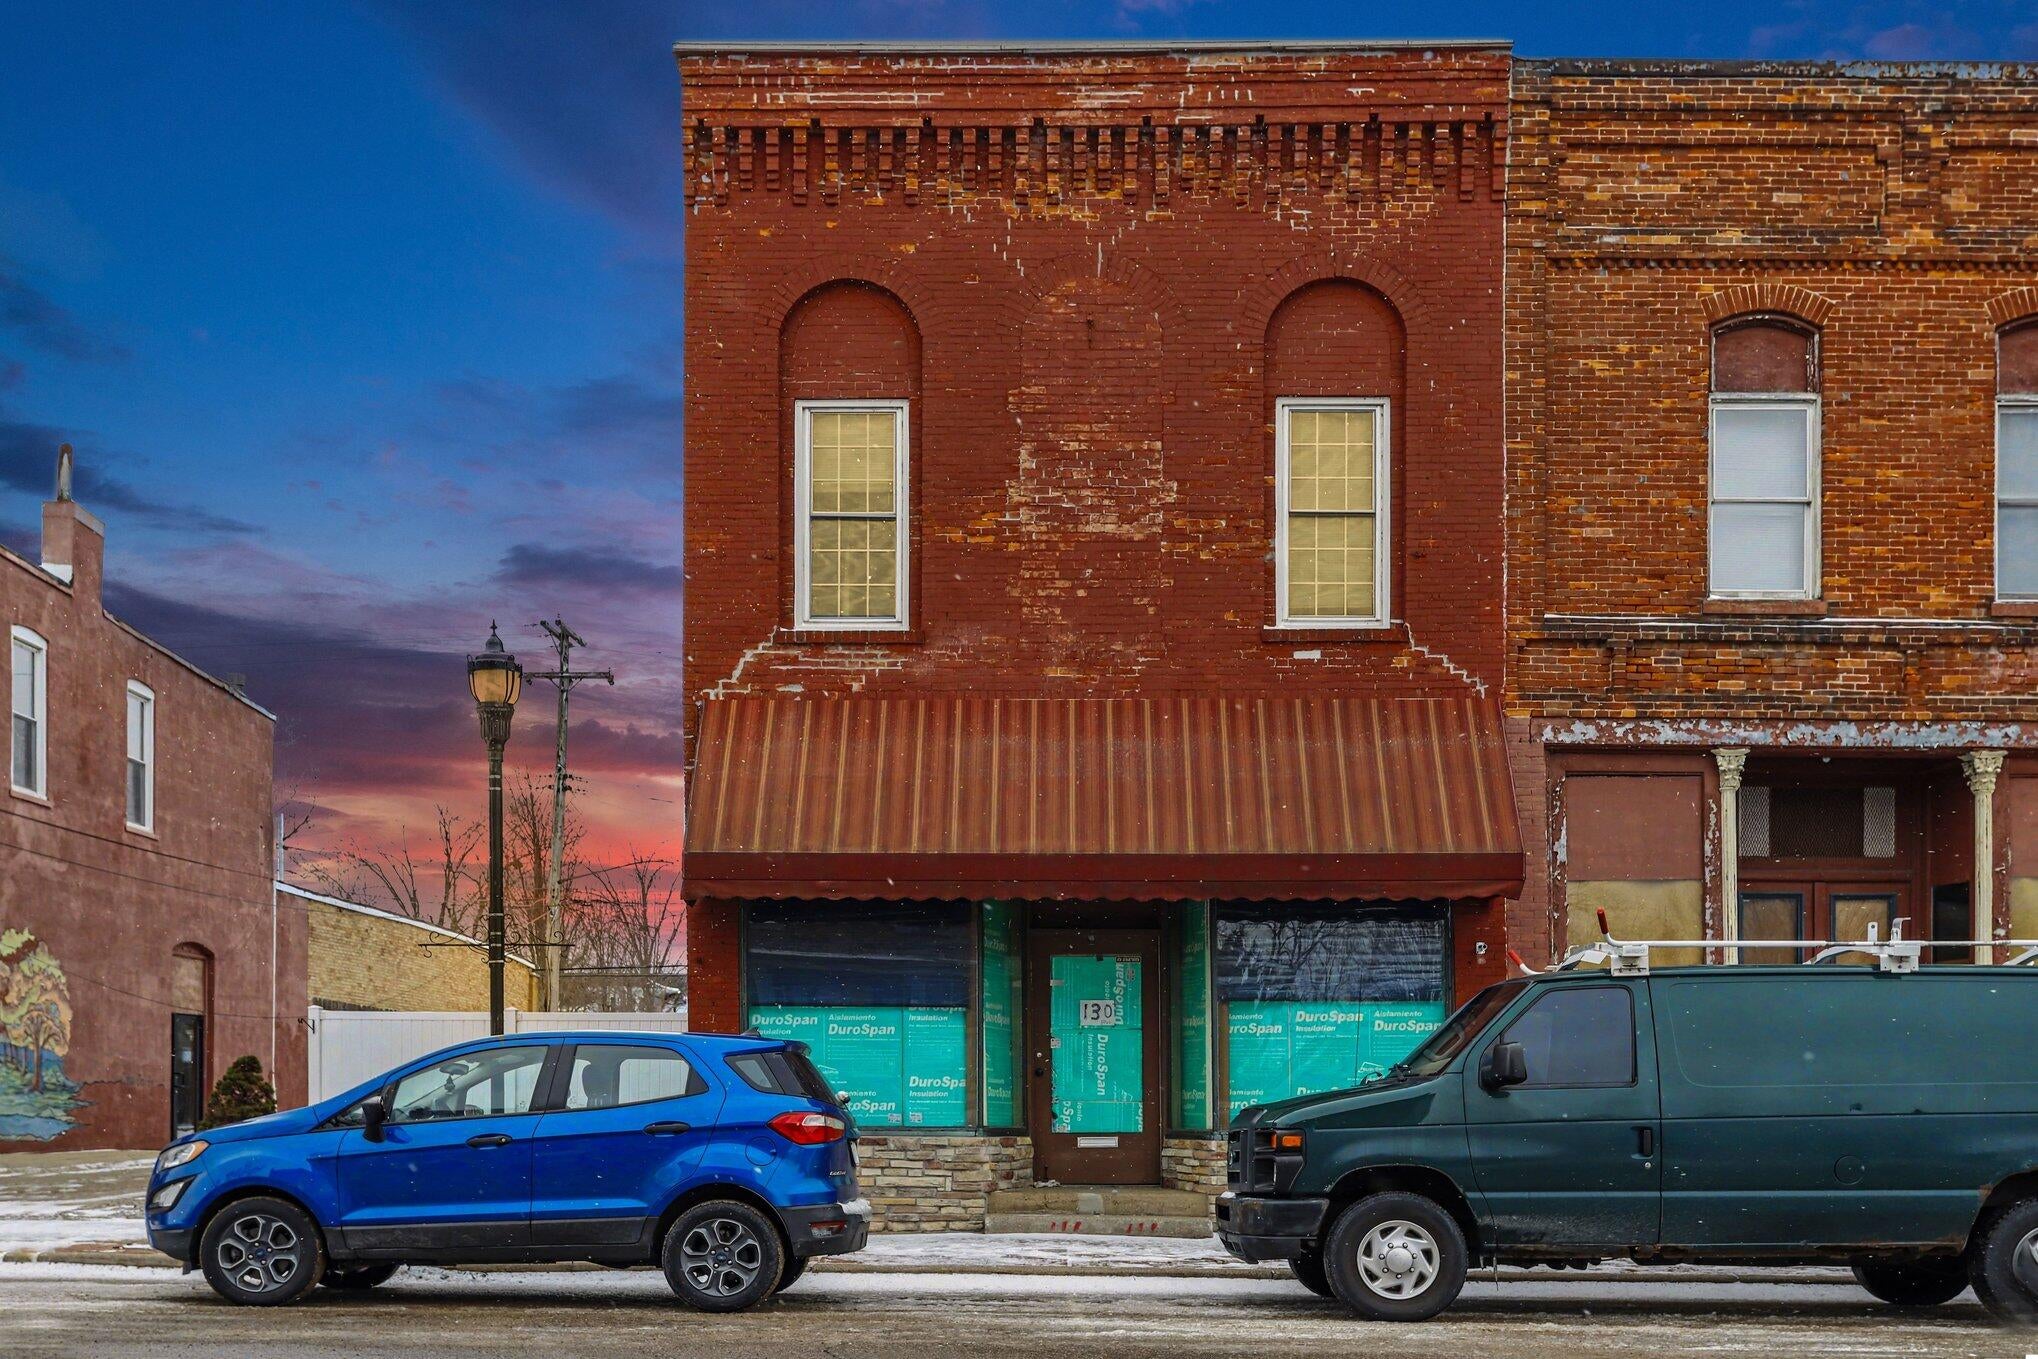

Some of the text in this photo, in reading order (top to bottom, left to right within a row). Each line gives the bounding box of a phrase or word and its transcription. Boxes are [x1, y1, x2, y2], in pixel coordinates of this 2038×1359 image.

[1113, 962, 1126, 1025] DuroSpan
[828, 1013, 877, 1021] Aislamiento
[909, 1013, 948, 1021] Insulation
[1083, 1003, 1113, 1021] 130
[1295, 1010, 1363, 1024] DuroSpan
[1373, 1010, 1423, 1018] Aislamiento
[751, 1013, 818, 1027] DuroSpan
[827, 1023, 896, 1037] DuroSpan
[1296, 1024, 1336, 1032] Insulation
[1087, 1033, 1095, 1071] Insulation
[1095, 1033, 1109, 1096] DuroSpan
[909, 1075, 967, 1090] DuroSpa
